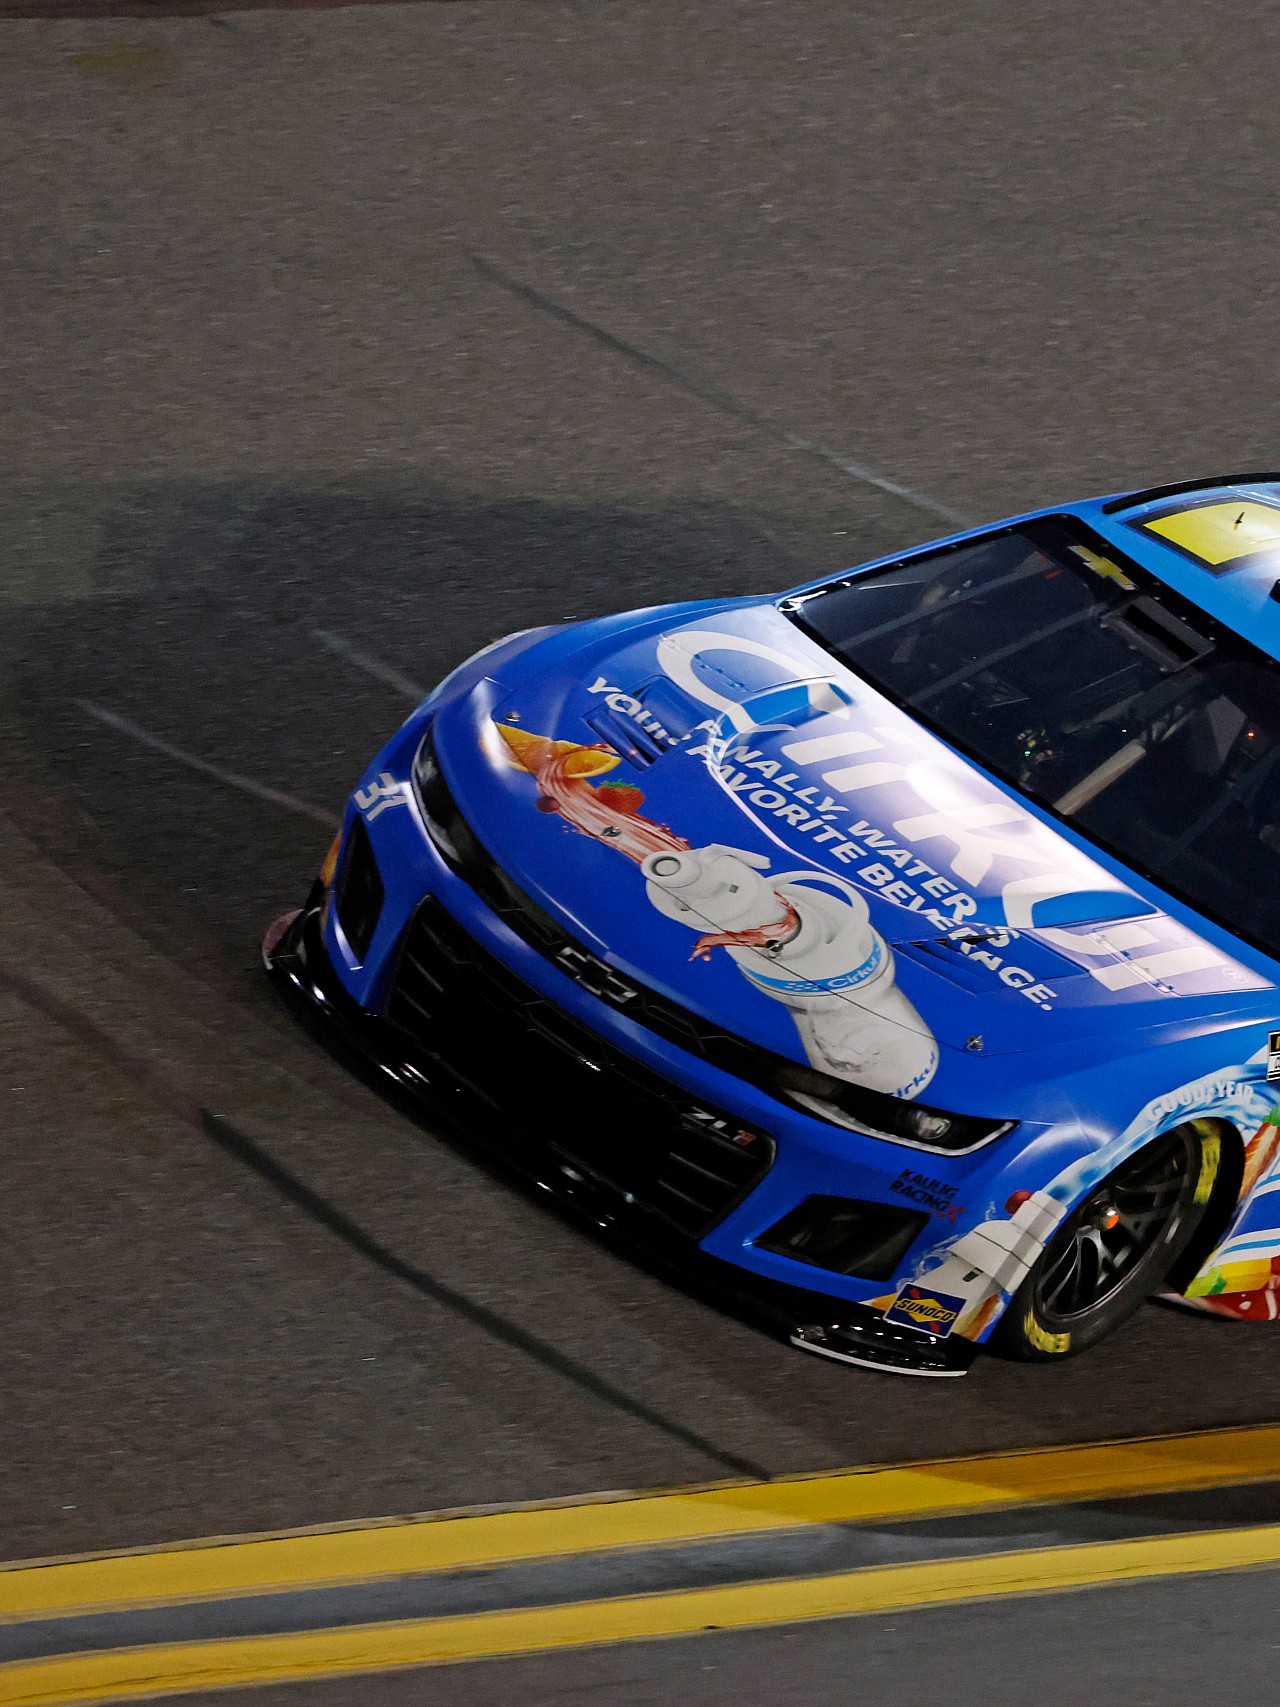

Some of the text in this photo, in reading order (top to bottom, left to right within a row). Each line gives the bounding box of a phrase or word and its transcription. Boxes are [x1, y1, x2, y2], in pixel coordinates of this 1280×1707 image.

[684, 744, 868, 864] FAVORITE
[848, 819, 978, 923] WATER
[888, 1179, 950, 1213] RACING
[900, 1168, 959, 1200] KAULIG
[899, 1299, 954, 1323] SUNOCO
